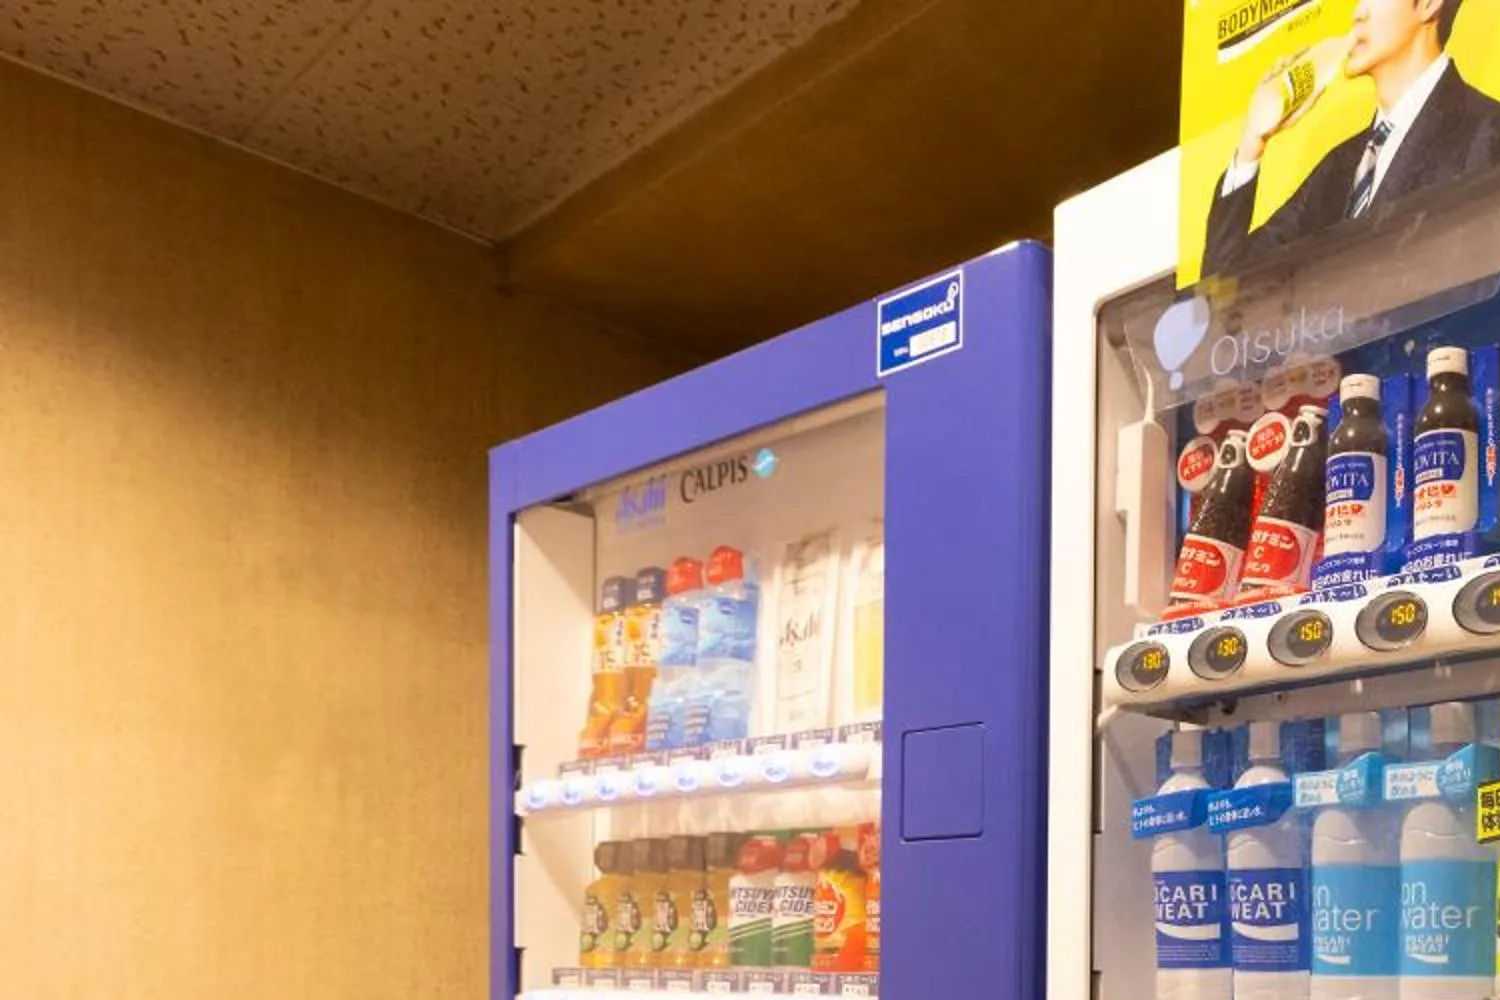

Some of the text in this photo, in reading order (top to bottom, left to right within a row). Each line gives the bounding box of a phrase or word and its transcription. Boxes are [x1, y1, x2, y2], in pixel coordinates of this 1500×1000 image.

[1211, 304, 1346, 376] Otsuka
[680, 455, 749, 504] CALPIS
[1391, 603, 1416, 625] 150
